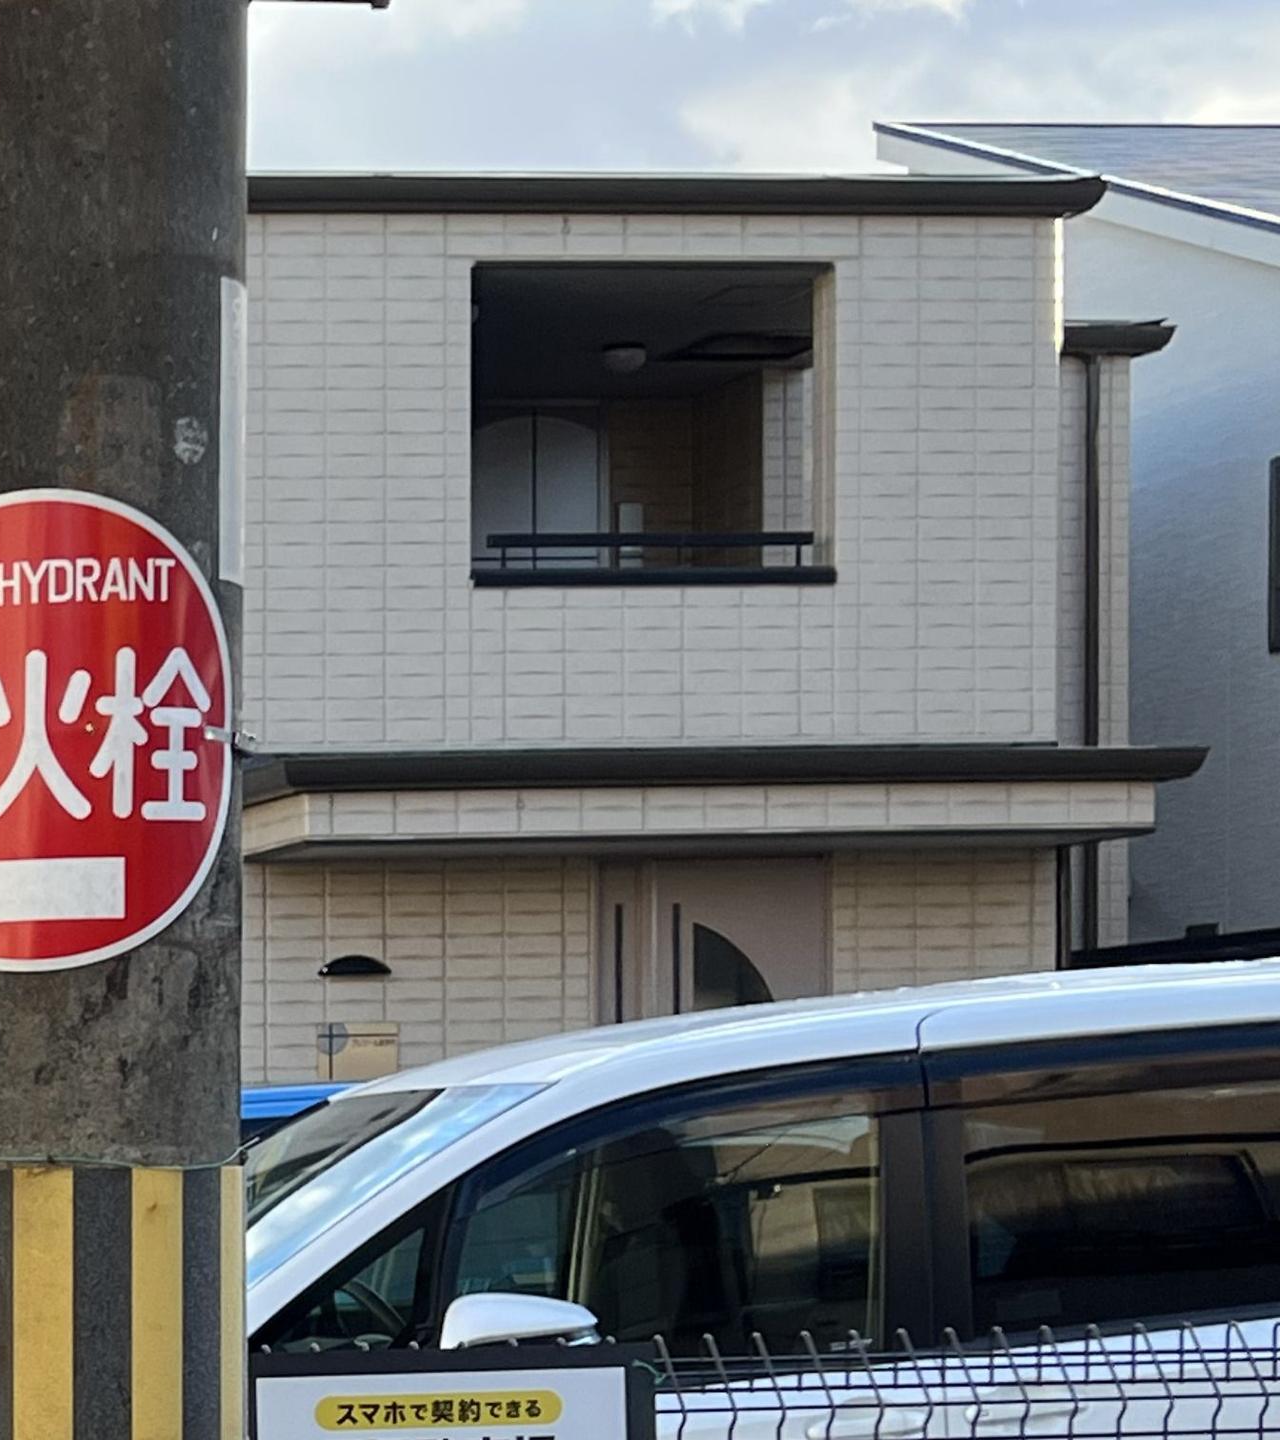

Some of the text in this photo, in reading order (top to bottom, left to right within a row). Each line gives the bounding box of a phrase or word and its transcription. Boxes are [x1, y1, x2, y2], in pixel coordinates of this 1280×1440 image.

[336, 1399, 542, 1426] スマホで契約できる
